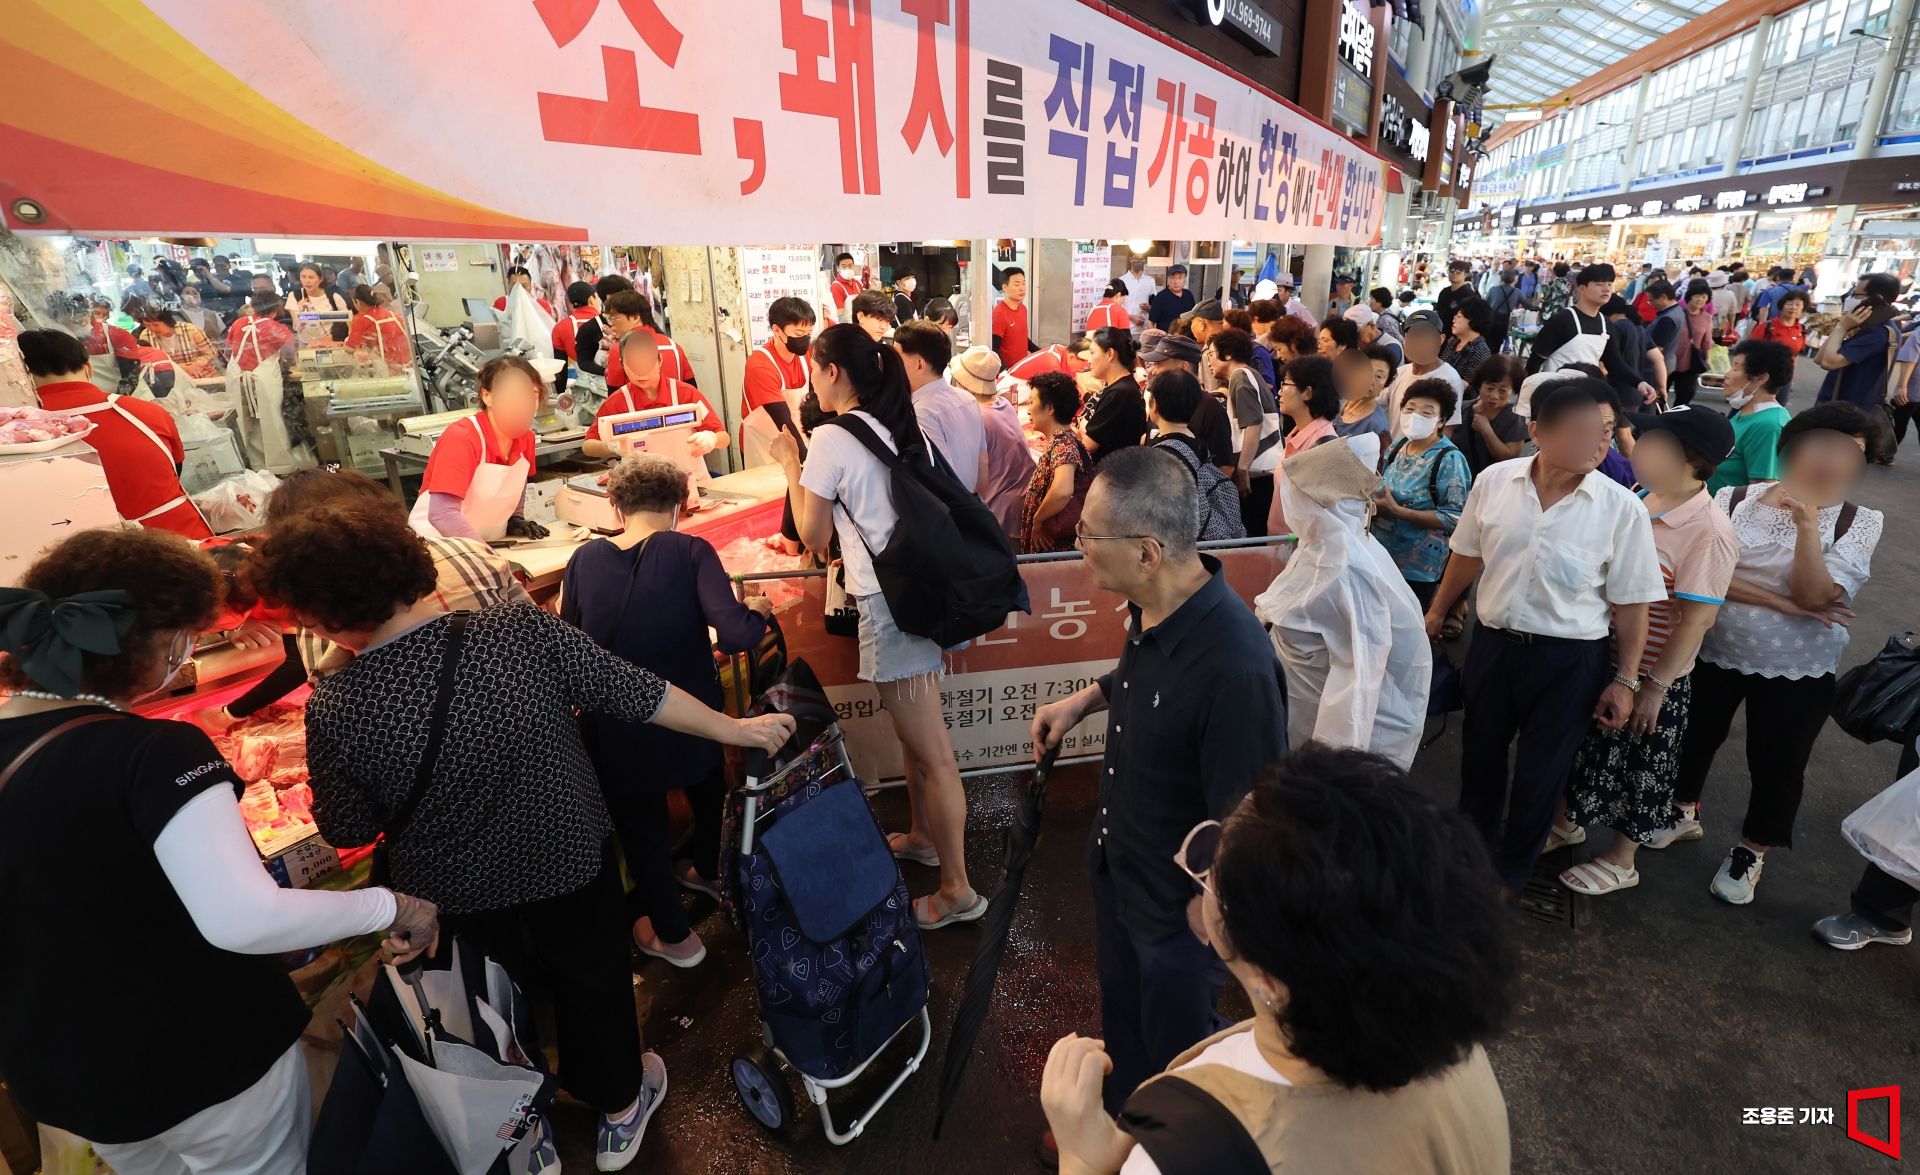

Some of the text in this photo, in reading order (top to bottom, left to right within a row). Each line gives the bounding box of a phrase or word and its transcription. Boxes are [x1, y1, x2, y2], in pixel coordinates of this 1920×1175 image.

[1043, 33, 1144, 208] 직접
[1147, 77, 1251, 219] 가공하여
[1254, 119, 1315, 226] 현장에서
[1313, 149, 1377, 234] 판매합니다
[940, 677, 1098, 708] 하절기 오전 7:30
[1001, 703, 1036, 721] 오전
[979, 743, 1017, 758] 기간엔
[1082, 733, 1105, 747] 실시
